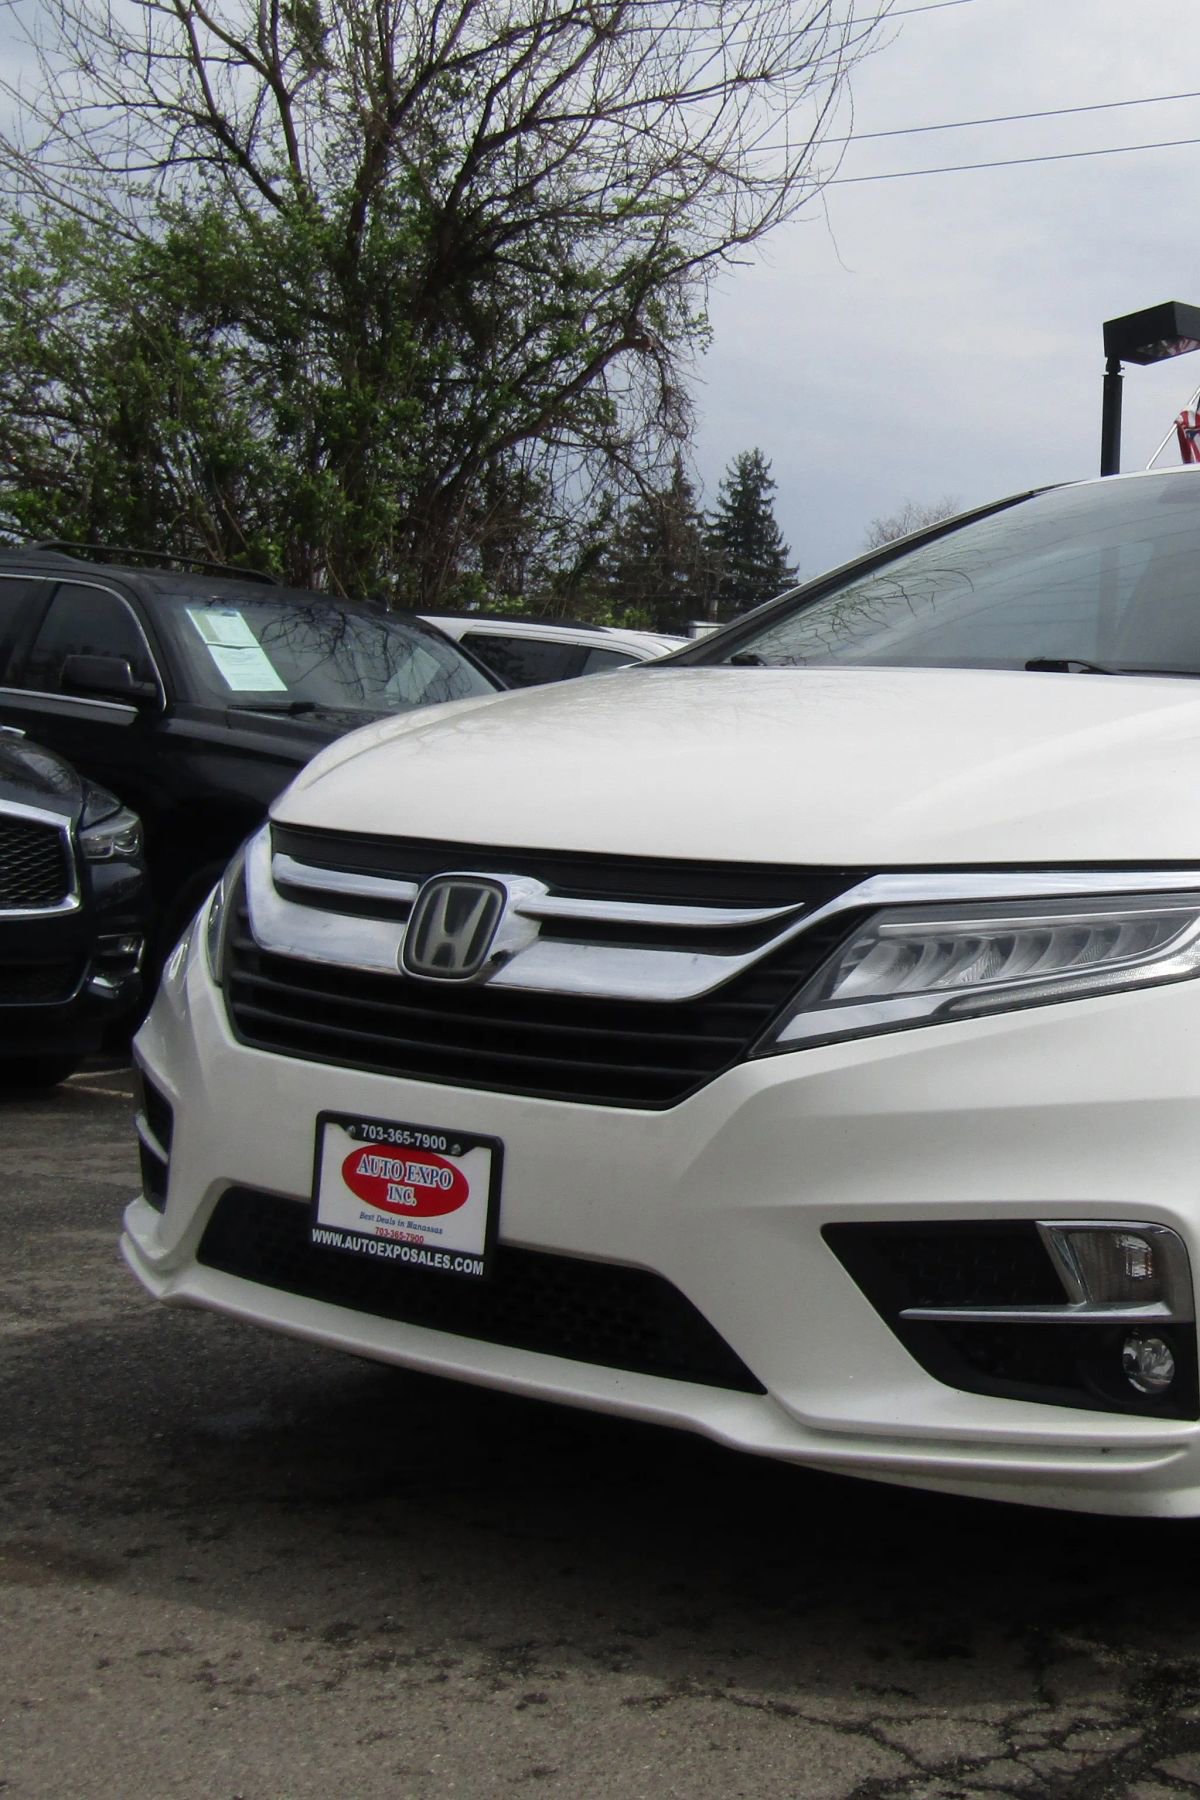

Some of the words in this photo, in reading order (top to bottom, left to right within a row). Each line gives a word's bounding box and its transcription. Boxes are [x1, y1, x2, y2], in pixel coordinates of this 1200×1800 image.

[361, 1124, 447, 1150] 703-365-7900
[356, 1154, 404, 1181] AUTO
[405, 1162, 454, 1190] EXPO
[387, 1184, 417, 1206] INC.
[359, 1211, 374, 1222] Best
[376, 1215, 396, 1227] Deals
[397, 1219, 405, 1228] in
[406, 1222, 444, 1236] Manassas
[375, 1226, 424, 1244] 703-365-7900
[312, 1228, 484, 1276] WWW.AUTOEXPOSALES.COM
